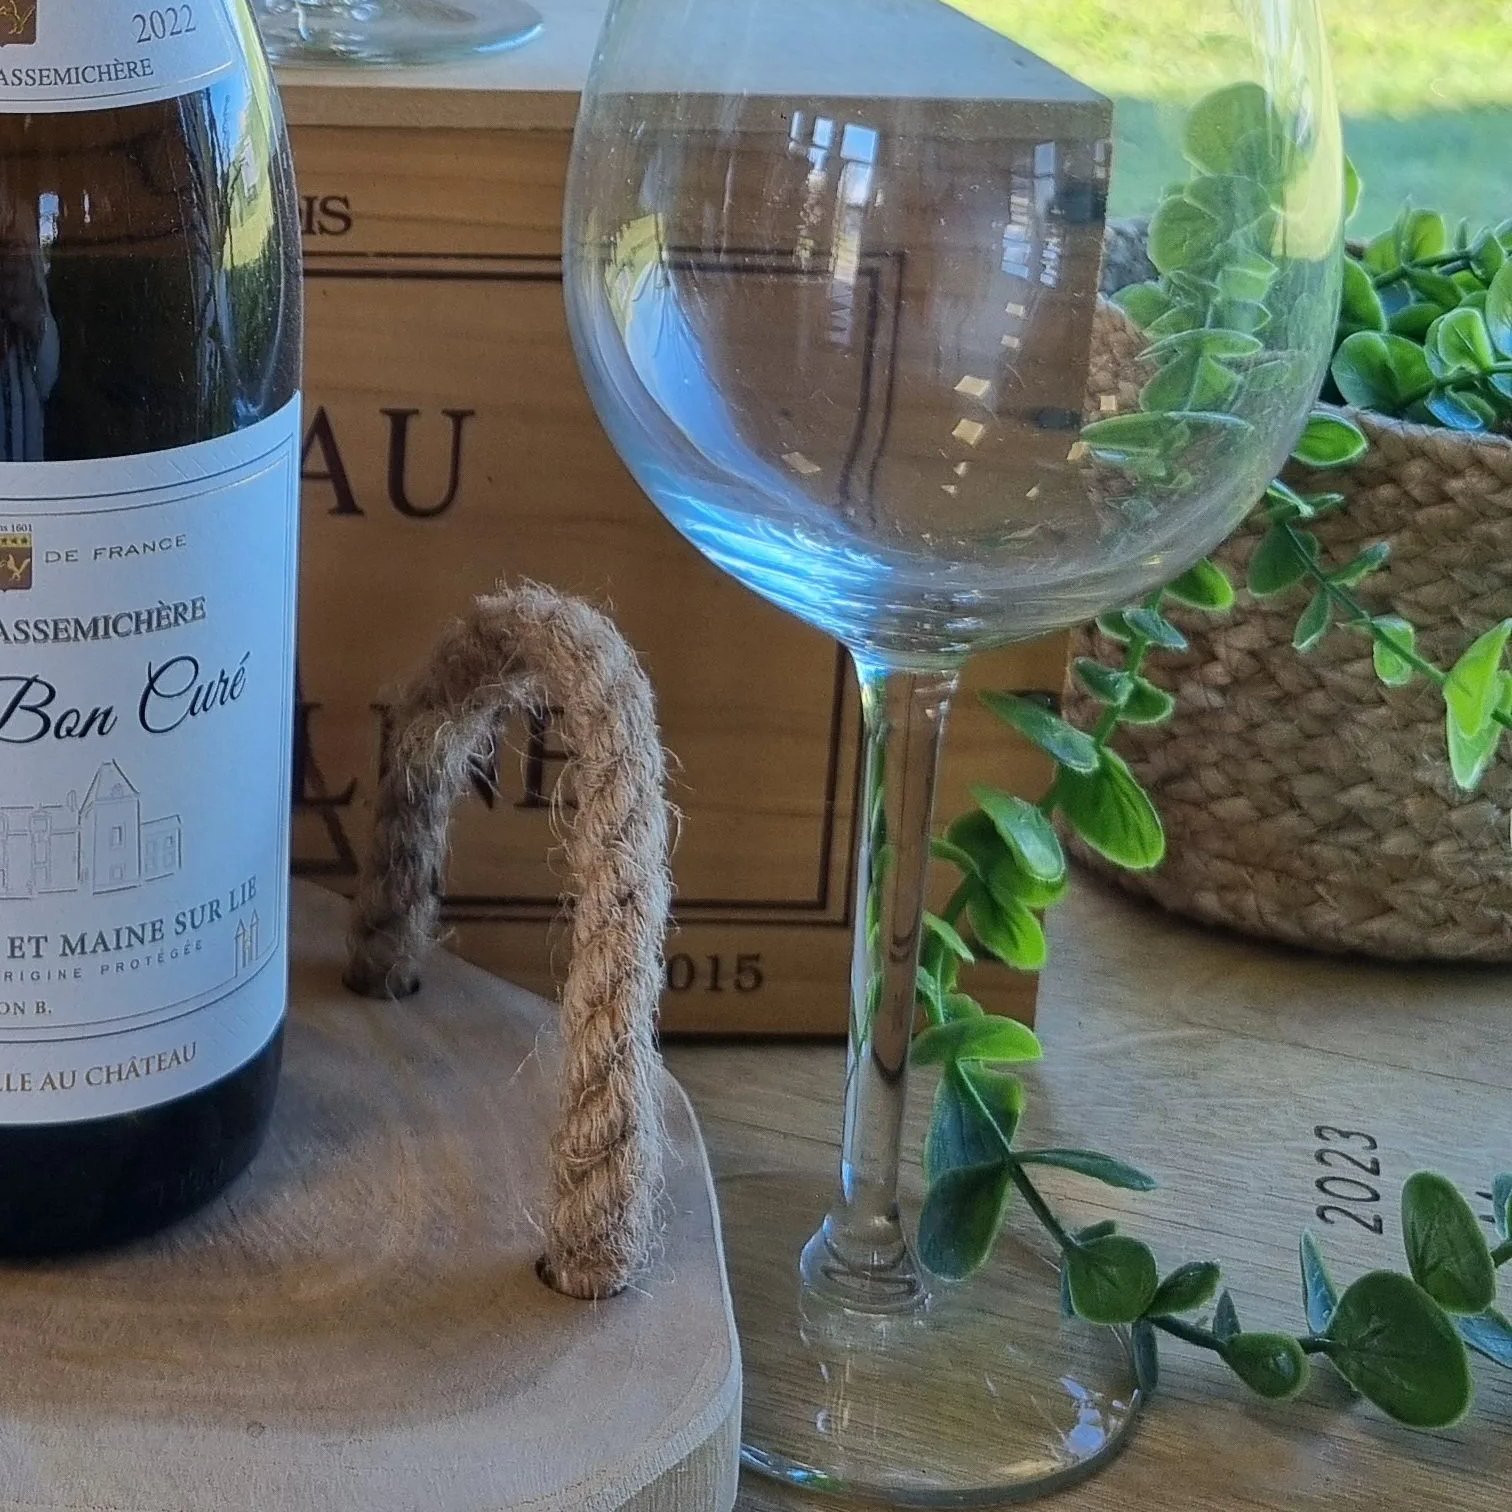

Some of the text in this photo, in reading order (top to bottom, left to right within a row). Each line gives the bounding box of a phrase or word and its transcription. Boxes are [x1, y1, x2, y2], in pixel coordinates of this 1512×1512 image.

[132, 4, 197, 44] 2022
[299, 195, 352, 236] IS
[10, 523, 33, 533] 1601
[44, 551, 79, 563] DE
[93, 535, 188, 560] FRANCE
[139, 651, 251, 734] Curé
[6, 935, 49, 959] ET
[58, 920, 165, 958] MAINE
[173, 904, 223, 936] SUR
[228, 874, 258, 913] LIE
[100, 938, 204, 976] PROTÉGÉE
[35, 1000, 53, 1015] B.
[39, 1069, 77, 1091] AU
[86, 1041, 198, 1087] CHÂTEAU
[1314, 1124, 1384, 1235] 2023
